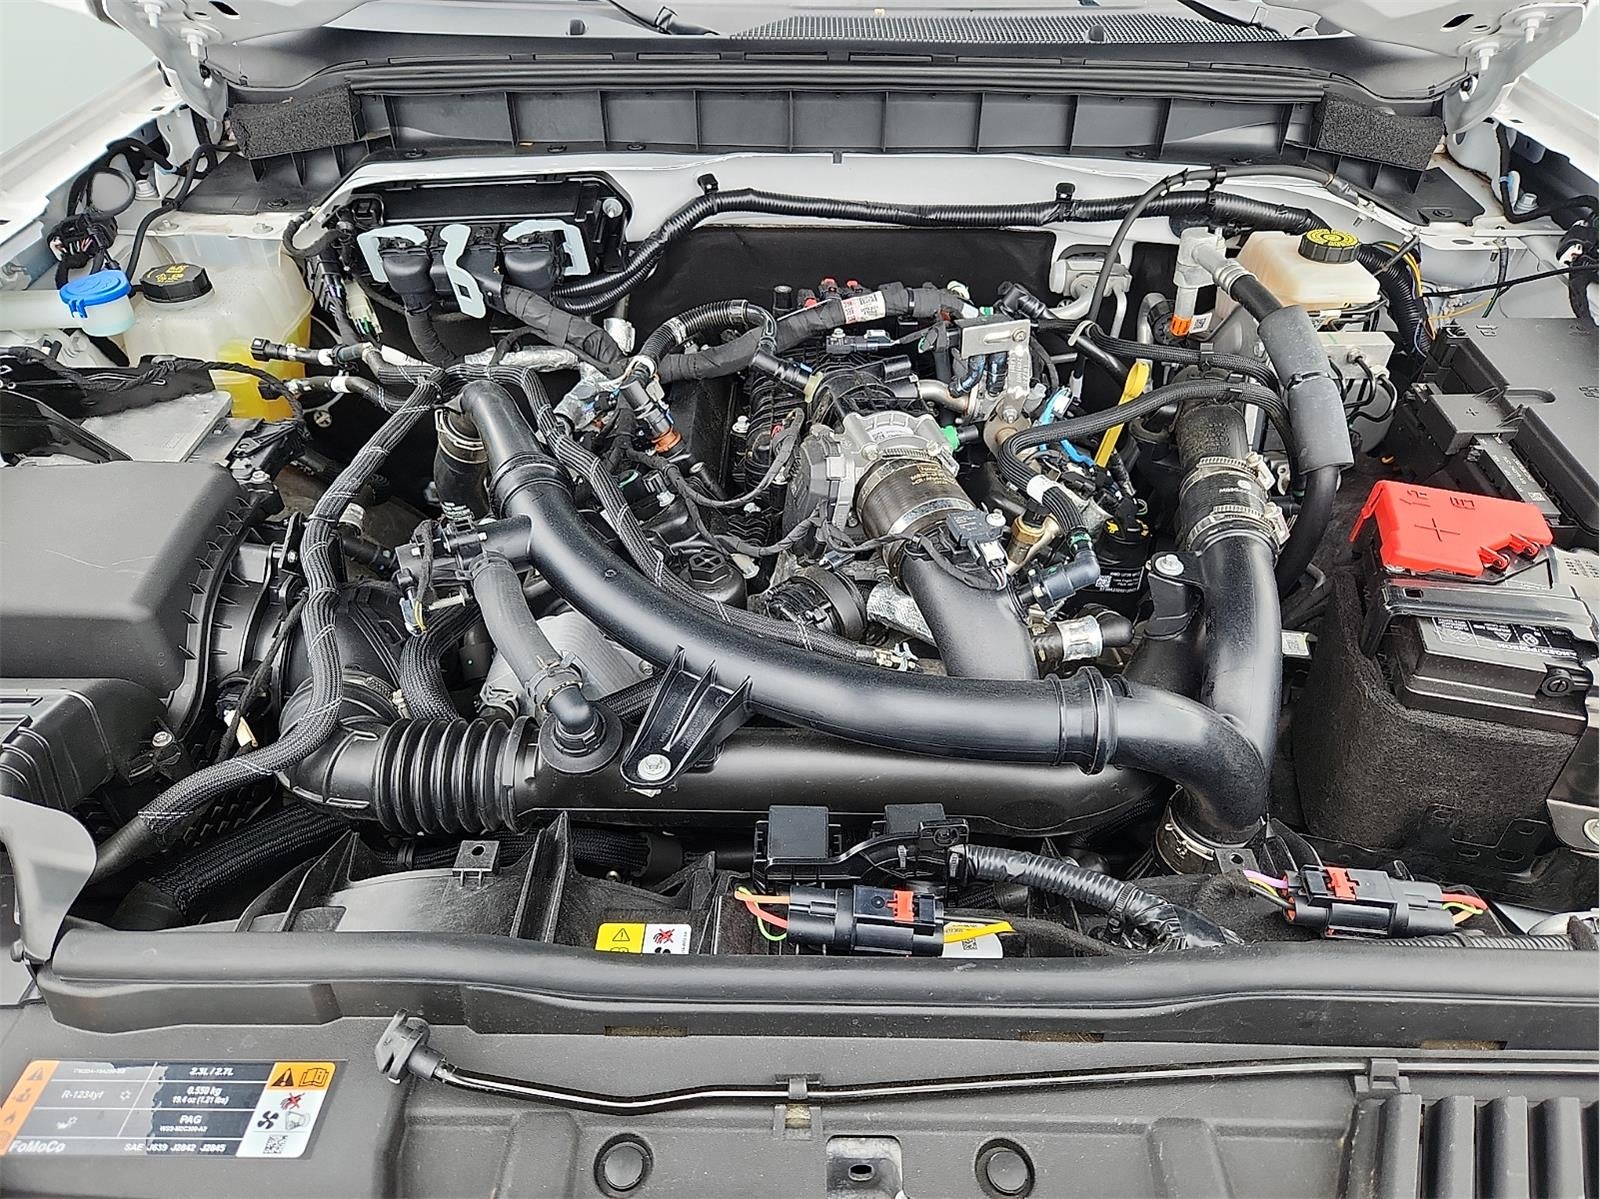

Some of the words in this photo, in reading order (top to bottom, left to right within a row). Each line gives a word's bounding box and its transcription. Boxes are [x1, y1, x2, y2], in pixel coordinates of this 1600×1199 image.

[61, 1090, 104, 1101] R-1234yf
[209, 1086, 222, 1097] kg
[179, 1115, 203, 1124] PAG
[8, 1140, 67, 1153] FoMoCo
[123, 1143, 144, 1152] SAE
[146, 1143, 169, 1152] J639
[170, 1143, 197, 1153] J2842
[199, 1143, 227, 1153] J2845
